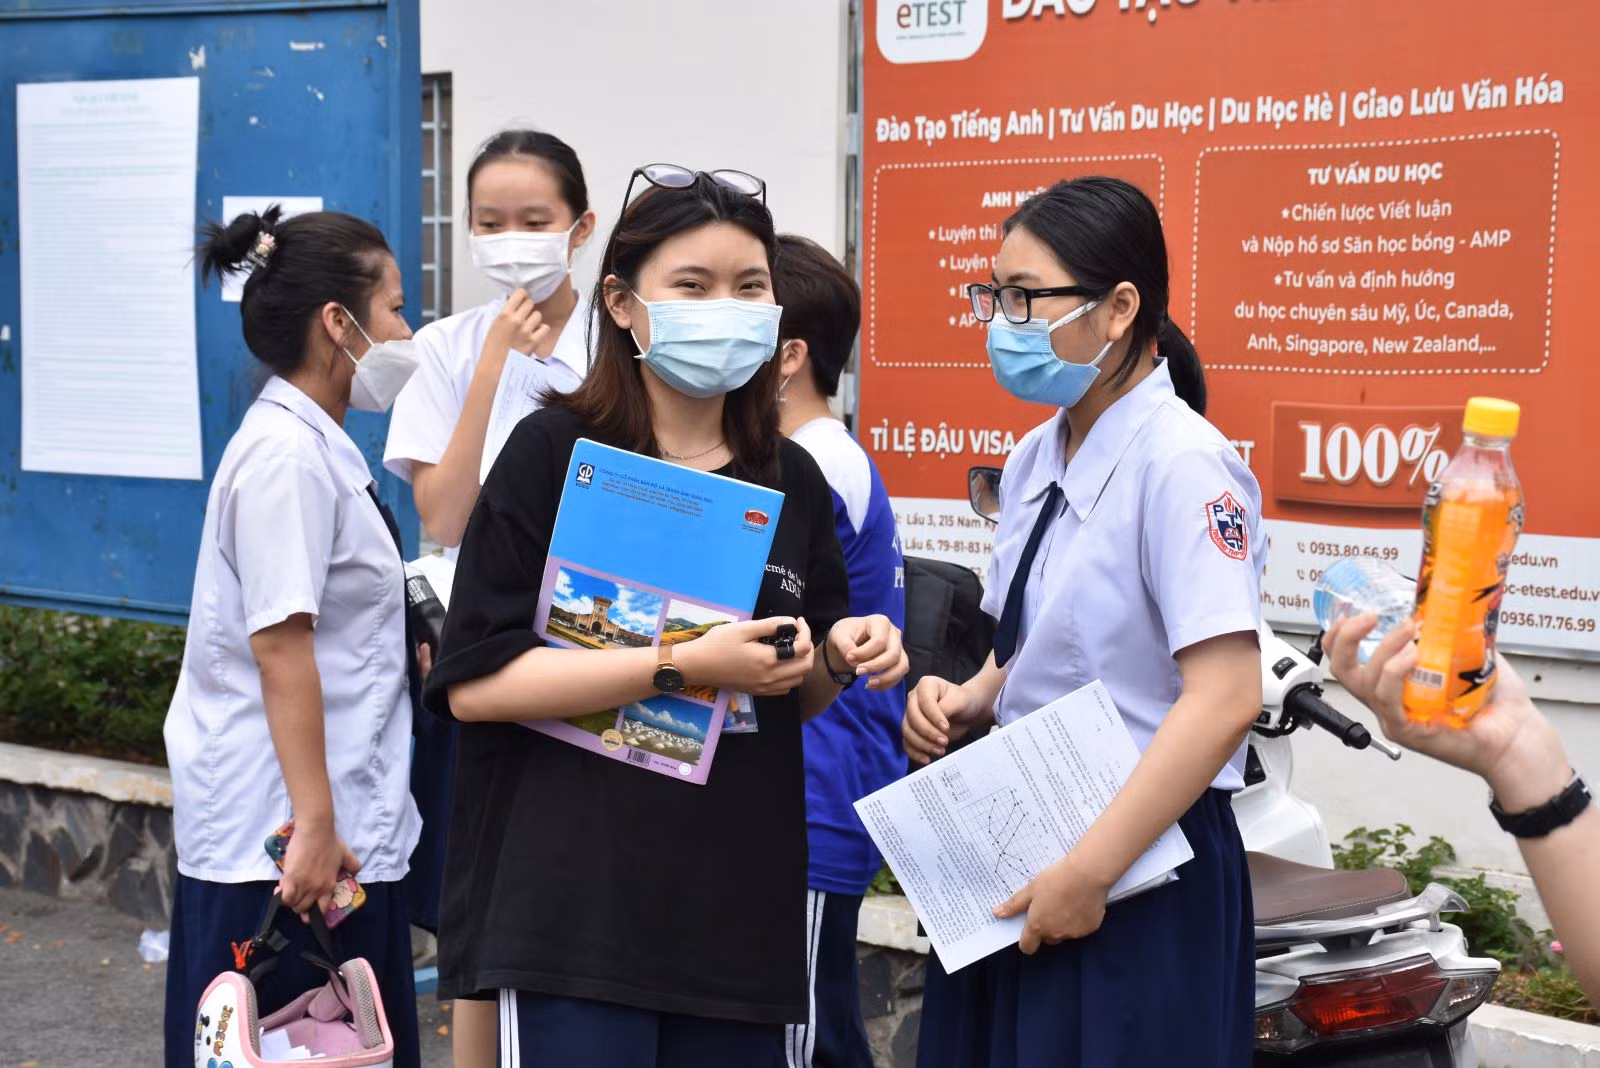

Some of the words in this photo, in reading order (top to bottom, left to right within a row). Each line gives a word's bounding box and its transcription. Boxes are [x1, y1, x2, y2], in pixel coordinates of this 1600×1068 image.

[897, 0, 967, 28] eTEST
[876, 116, 910, 142] Đào
[915, 116, 946, 146] Tạo
[951, 109, 1001, 142] Tiếng
[1006, 108, 1043, 136] Anh
[1060, 108, 1084, 132] Tư
[1088, 102, 1124, 131] Vấn
[1132, 104, 1158, 129] Du
[1164, 102, 1203, 133] Học
[1222, 98, 1250, 124] Du
[1256, 96, 1298, 128] Học
[1304, 92, 1333, 120] Hè
[1353, 88, 1403, 119] Giao
[1410, 88, 1454, 115] Lưu
[1462, 80, 1507, 110] Văn
[1515, 73, 1563, 105] Hóa
[1308, 166, 1331, 184] TƯ
[1334, 162, 1370, 184] VẤN
[1375, 166, 1400, 182] DU
[1404, 162, 1442, 184] HỌC
[981, 191, 1012, 208] ANH
[1292, 203, 1336, 221] Chiến
[1342, 204, 1374, 224] lược
[1379, 200, 1410, 219] Viết
[1416, 199, 1452, 220] luận
[939, 225, 976, 244] Luyện
[980, 224, 996, 240] thi
[1242, 236, 1258, 252] và
[1264, 236, 1294, 256] Nộp
[1298, 236, 1318, 253] hồ
[1322, 239, 1340, 254] sơ
[1344, 236, 1372, 253] Săn
[1378, 236, 1406, 256] học
[1412, 232, 1454, 254] bổng
[1470, 230, 1510, 248] AMP
[949, 253, 989, 273] Luyện
[1284, 271, 1303, 288] Tư
[1306, 270, 1334, 288] vấn
[1338, 272, 1356, 288] và
[1360, 270, 1396, 291] định
[1402, 269, 1454, 289] hướng
[1235, 302, 1254, 318] du
[1258, 302, 1286, 321] học
[1290, 304, 1346, 324] chuyên
[1351, 304, 1378, 320] sâu
[1384, 304, 1409, 324] Mỹ,
[1415, 300, 1440, 321] Úc,
[1445, 300, 1513, 320] Canada,
[1248, 334, 1281, 352] Anh,
[1286, 334, 1368, 356] Singapore,
[1373, 338, 1408, 353] New
[870, 419, 888, 450] TỈ
[894, 422, 916, 457] LỆ
[920, 423, 964, 458] ĐẬU
[969, 428, 1016, 455] VISA
[1299, 420, 1449, 485] 100%
[927, 514, 936, 527] 3,
[939, 515, 955, 527] 215
[957, 517, 981, 528] Nam
[926, 540, 935, 553] 6,
[937, 540, 981, 553] 79-81-83
[1310, 541, 1399, 560] 0933.80.66.99
[1500, 611, 1596, 632] 0936.17.76.99
